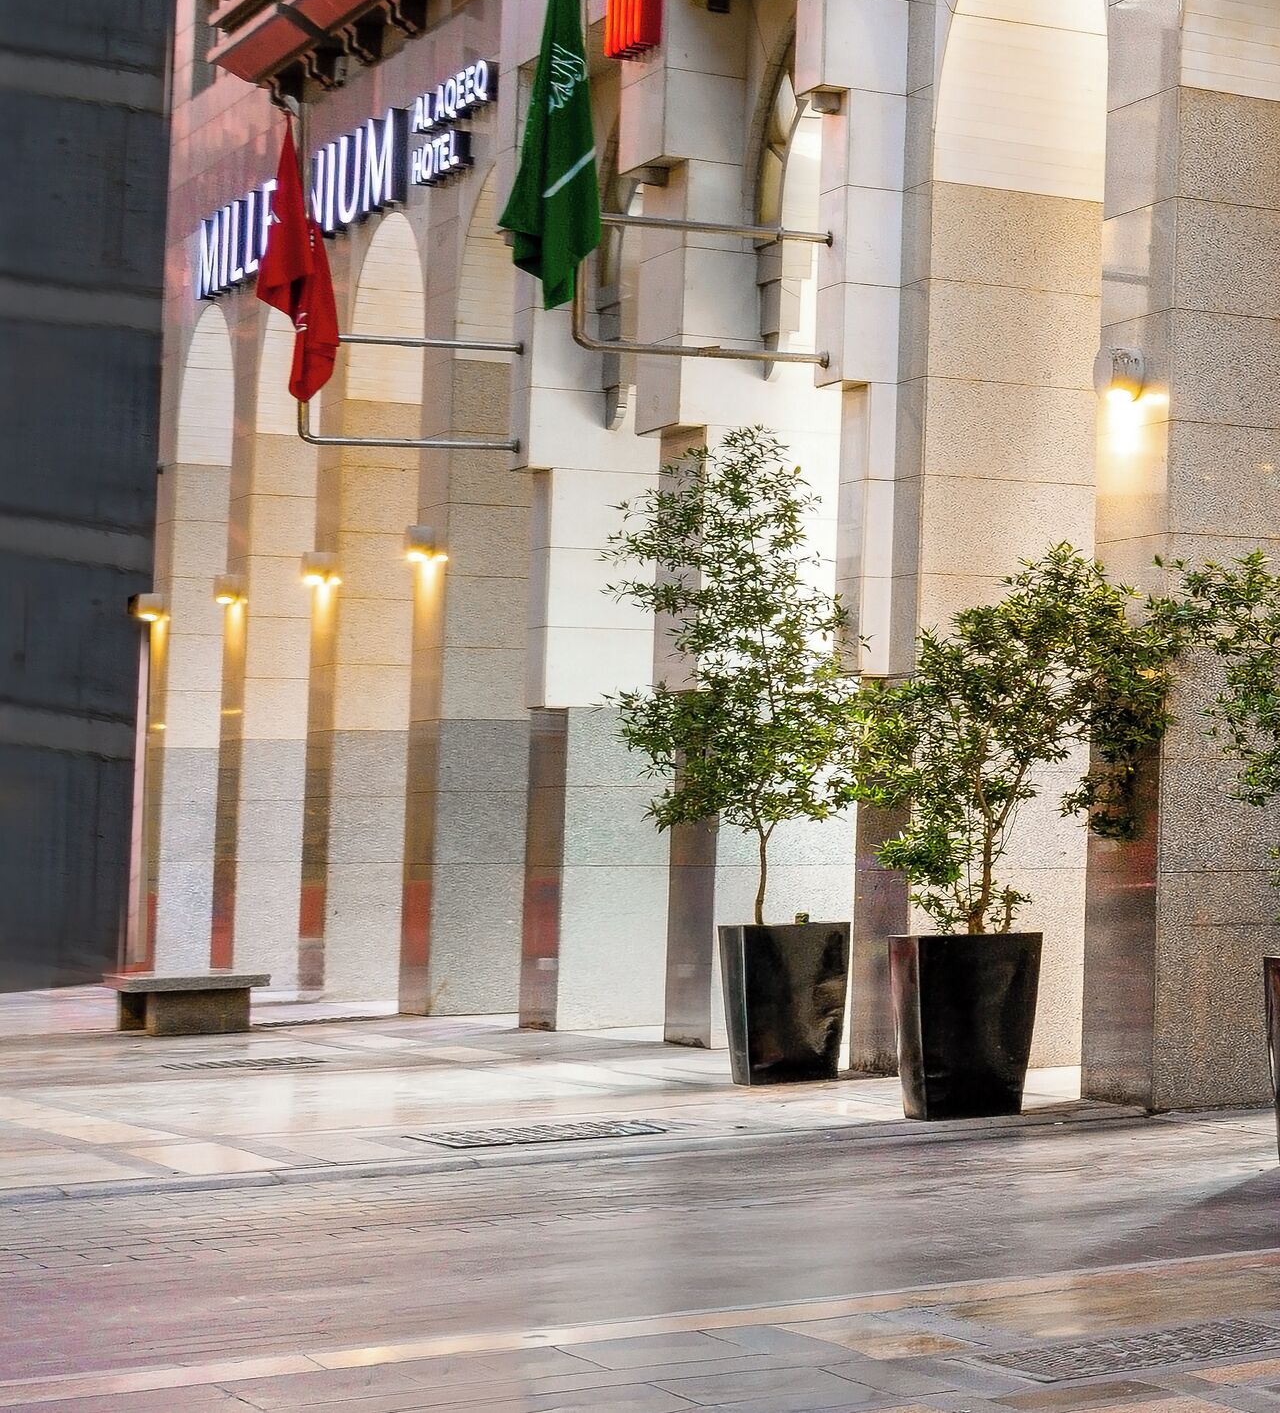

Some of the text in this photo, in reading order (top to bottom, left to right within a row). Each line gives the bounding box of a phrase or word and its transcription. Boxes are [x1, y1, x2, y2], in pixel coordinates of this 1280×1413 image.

[412, 94, 435, 133] AL
[436, 58, 489, 119] AQEEQ
[411, 129, 460, 185] HOTEL
[196, 107, 394, 301] MILLENIUM
